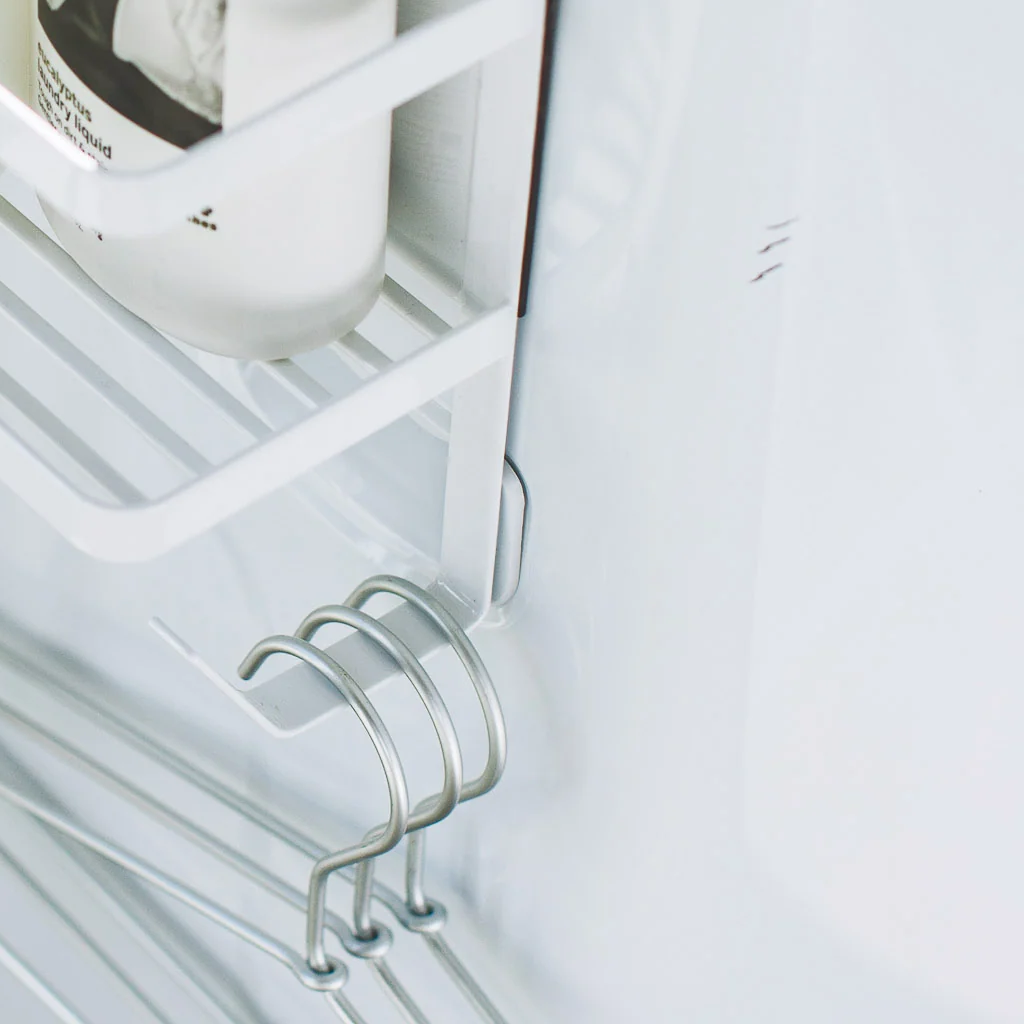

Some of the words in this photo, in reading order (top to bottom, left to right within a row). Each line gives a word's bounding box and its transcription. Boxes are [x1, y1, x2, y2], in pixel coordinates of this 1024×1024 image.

[37, 56, 71, 122] laundry
[75, 114, 112, 160] liquid
[38, 42, 92, 123] eucalyptus
